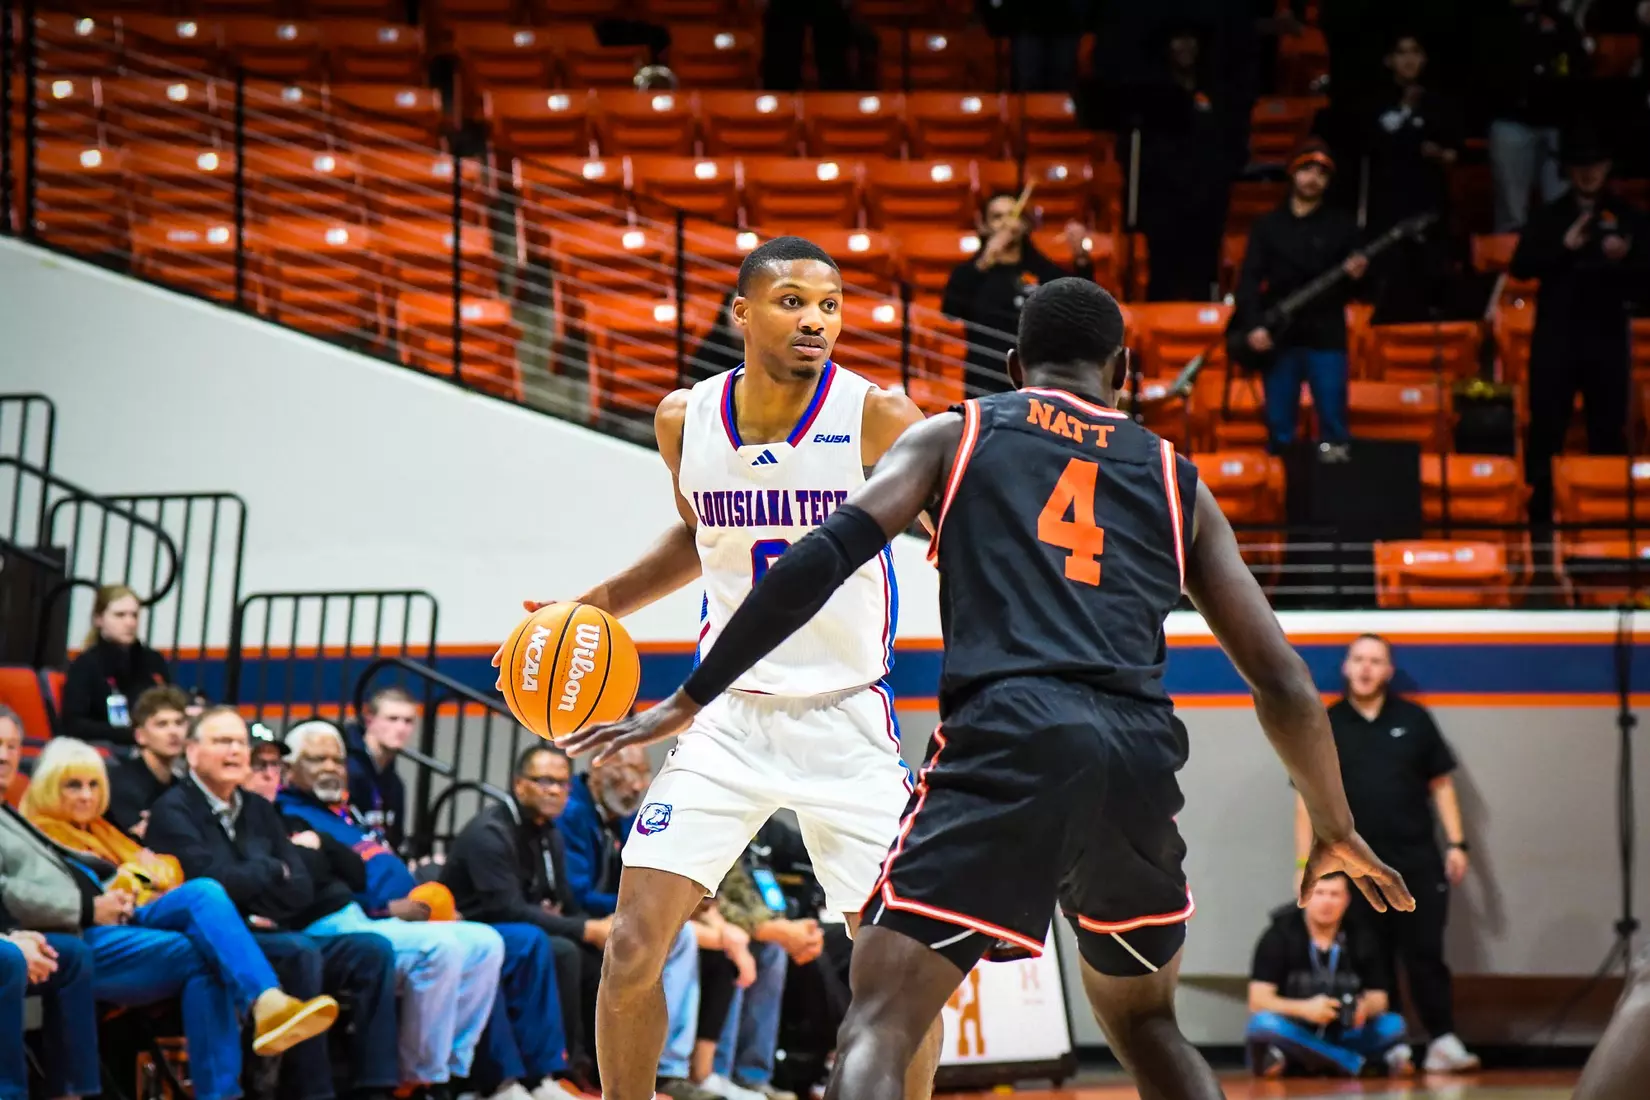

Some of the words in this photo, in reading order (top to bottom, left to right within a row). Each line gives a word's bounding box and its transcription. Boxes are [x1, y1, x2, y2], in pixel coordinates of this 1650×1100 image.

[1026, 398, 1115, 447] NATT
[693, 490, 793, 527] LOUISIANA
[1037, 457, 1104, 586] 4
[521, 624, 552, 692] NCAA
[557, 623, 600, 712] Wilson
